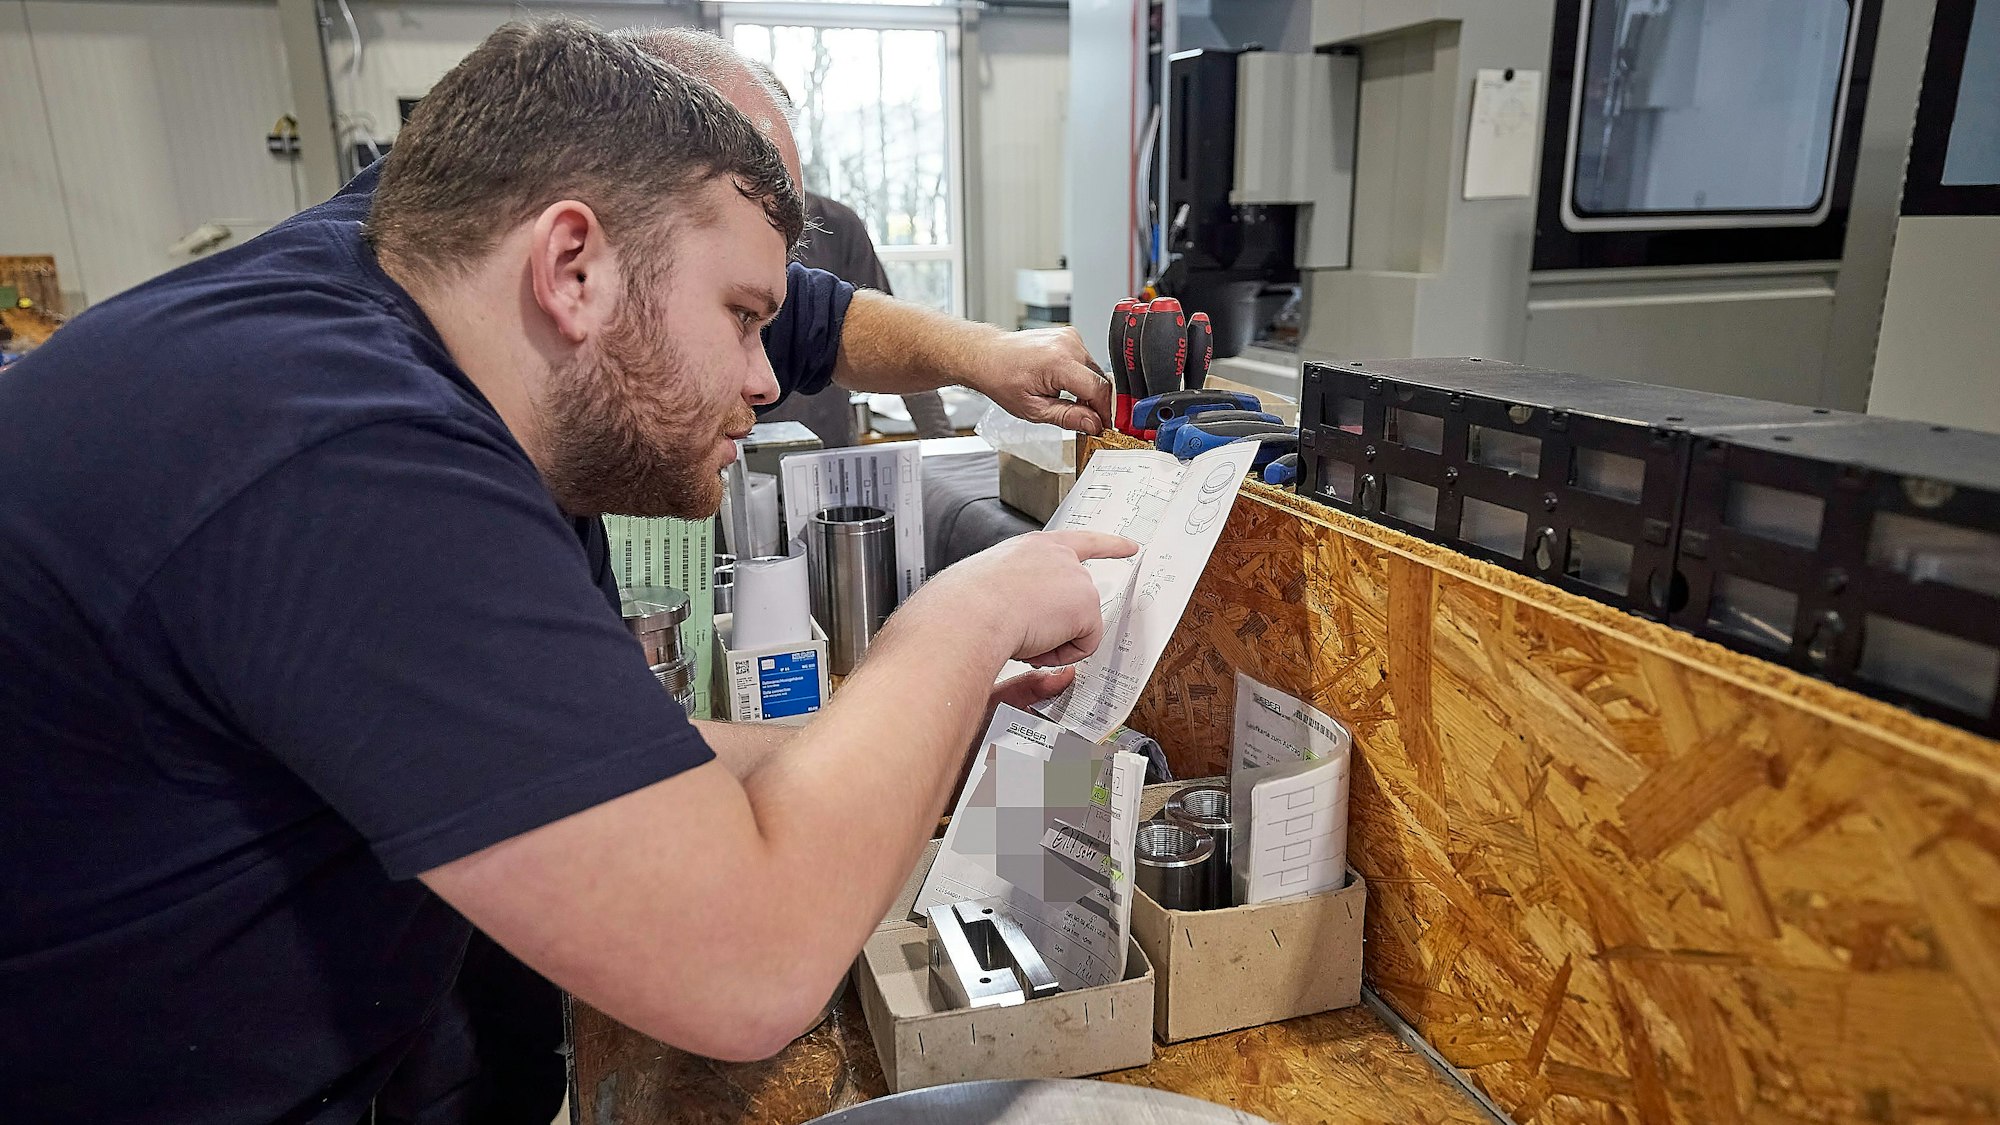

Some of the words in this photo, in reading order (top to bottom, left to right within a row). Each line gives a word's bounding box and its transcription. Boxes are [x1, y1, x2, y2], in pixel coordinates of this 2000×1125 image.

[1125, 337, 1135, 371] wiha
[1174, 337, 1186, 376] wiha
[1203, 346, 1213, 370] wiha
[1009, 722, 1047, 743] SIEBER
